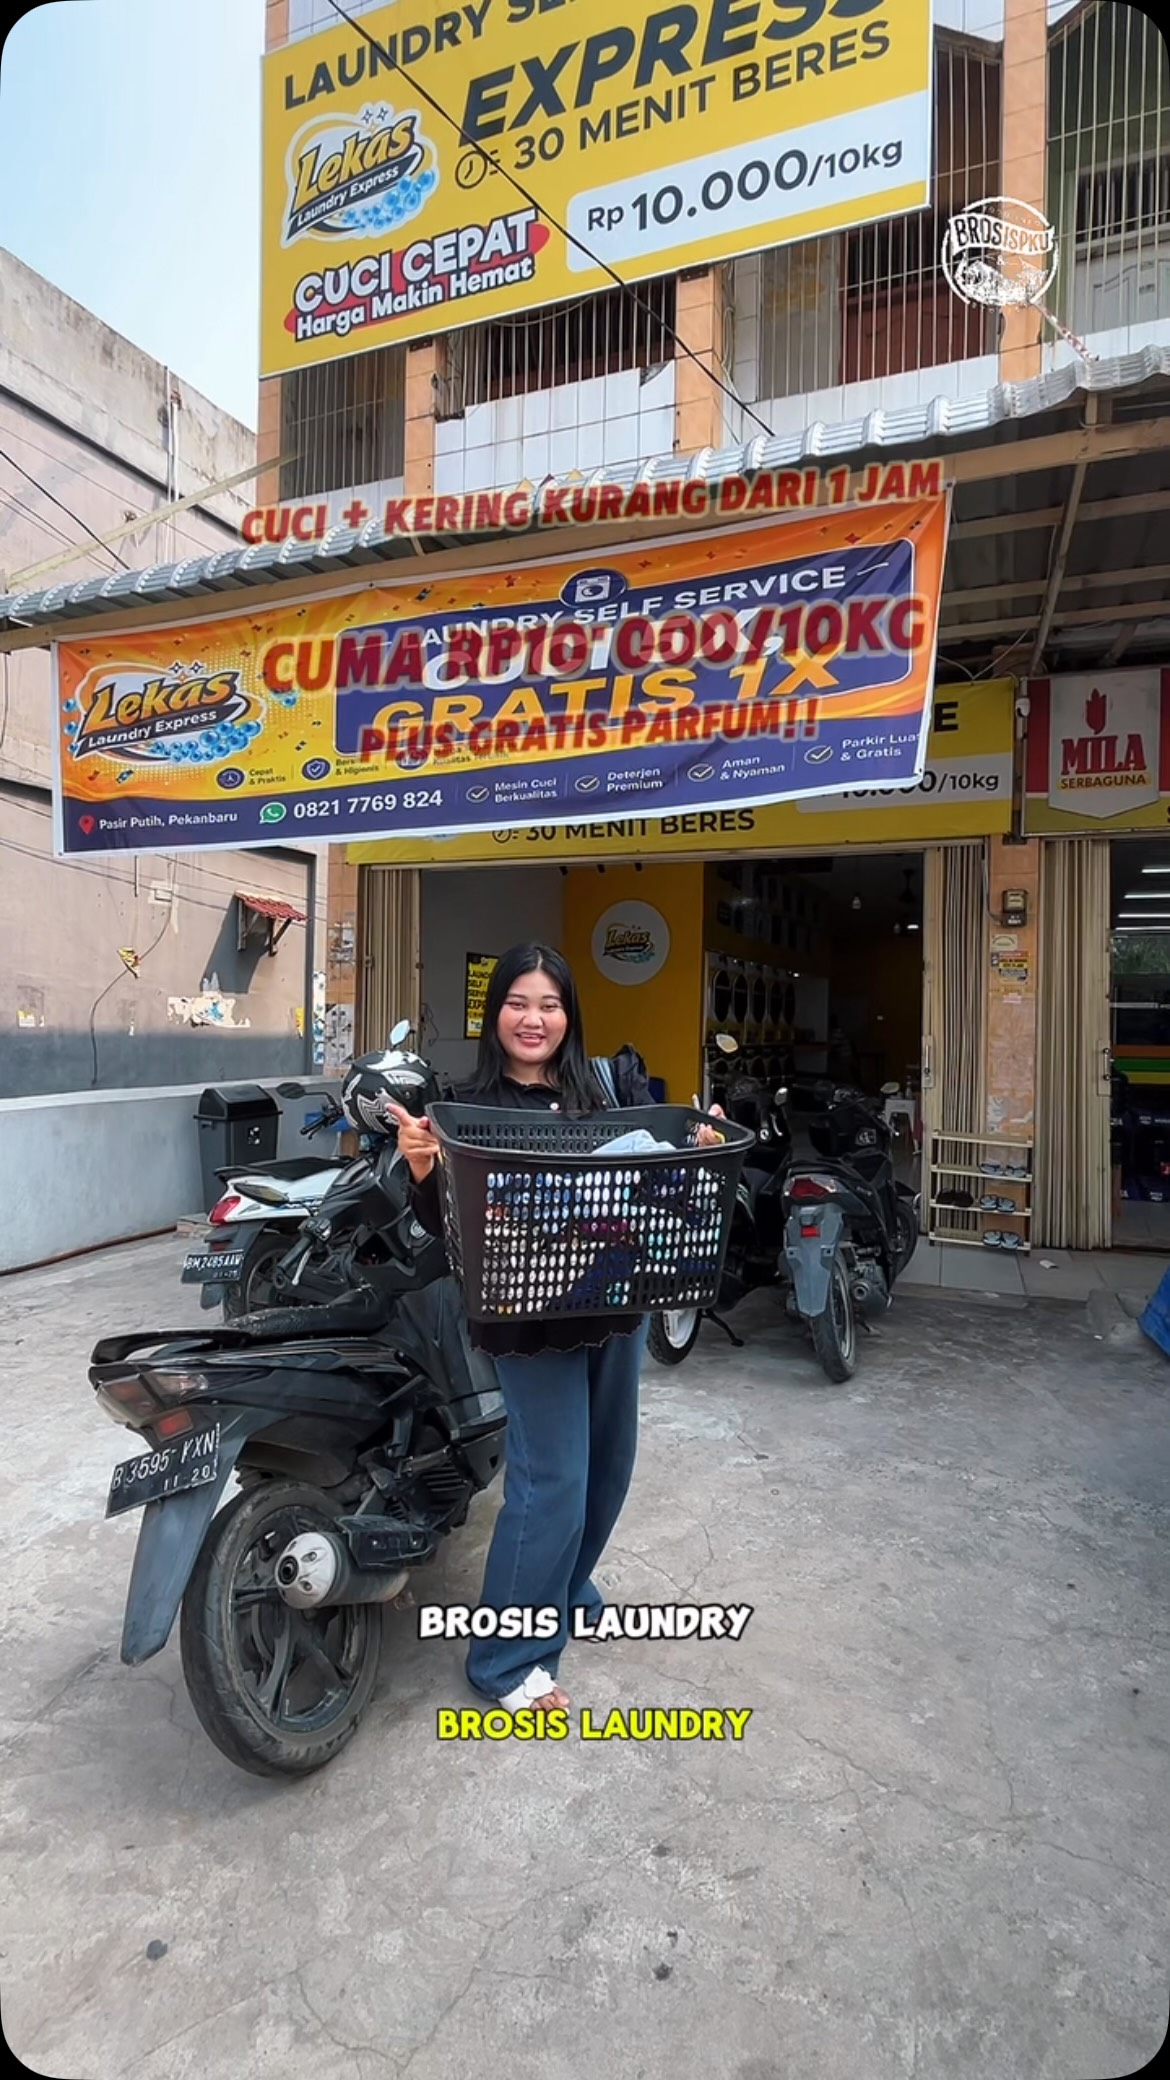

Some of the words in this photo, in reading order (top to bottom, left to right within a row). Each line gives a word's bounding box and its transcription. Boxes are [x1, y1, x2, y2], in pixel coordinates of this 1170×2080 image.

[285, 0, 492, 110] LAUNDRY
[514, 127, 565, 170] 30
[580, 75, 716, 150] MENIT
[732, 20, 890, 102] BERES
[290, 115, 417, 215] Lekas
[297, 190, 348, 226] Laundry
[350, 165, 400, 198] Express
[587, 205, 624, 231] Rp
[631, 140, 903, 231] 10.000/10kg
[295, 250, 392, 313] CUCI
[402, 207, 538, 281] CEPAT
[296, 304, 366, 341] Harga
[371, 280, 443, 320] Makin
[449, 256, 535, 300] Hemat
[573, 596, 664, 625] SELF
[673, 566, 847, 609] SERVICE
[82, 671, 240, 735] Lekas
[371, 668, 698, 745] GRATIS
[729, 640, 847, 700] 1X
[87, 725, 151, 748] Laundry
[155, 709, 218, 734] Express
[842, 736, 885, 749] Parkir
[720, 771, 730, 781] &
[733, 764, 785, 779] Nyaman
[722, 756, 760, 769] Aman
[840, 752, 850, 762] &
[856, 748, 901, 760] Gratis
[1061, 734, 1147, 775] MILA
[495, 780, 528, 792] Mesin
[531, 777, 557, 788] Cuci
[607, 768, 661, 781] Deterjen
[607, 780, 663, 792] Premium
[1061, 774, 1146, 789] SERBAGUNA
[293, 799, 340, 818] 0821
[347, 794, 397, 814] 7769
[403, 789, 442, 808] 824
[495, 789, 558, 803] Berkualitas
[99, 818, 127, 829] Pasir
[130, 815, 165, 829] Putih,
[168, 810, 238, 825] Pekanbaru
[565, 818, 647, 839] MENIT
[660, 808, 755, 835] BERES
[112, 1466, 124, 1491] B
[127, 1448, 171, 1483] 3595
